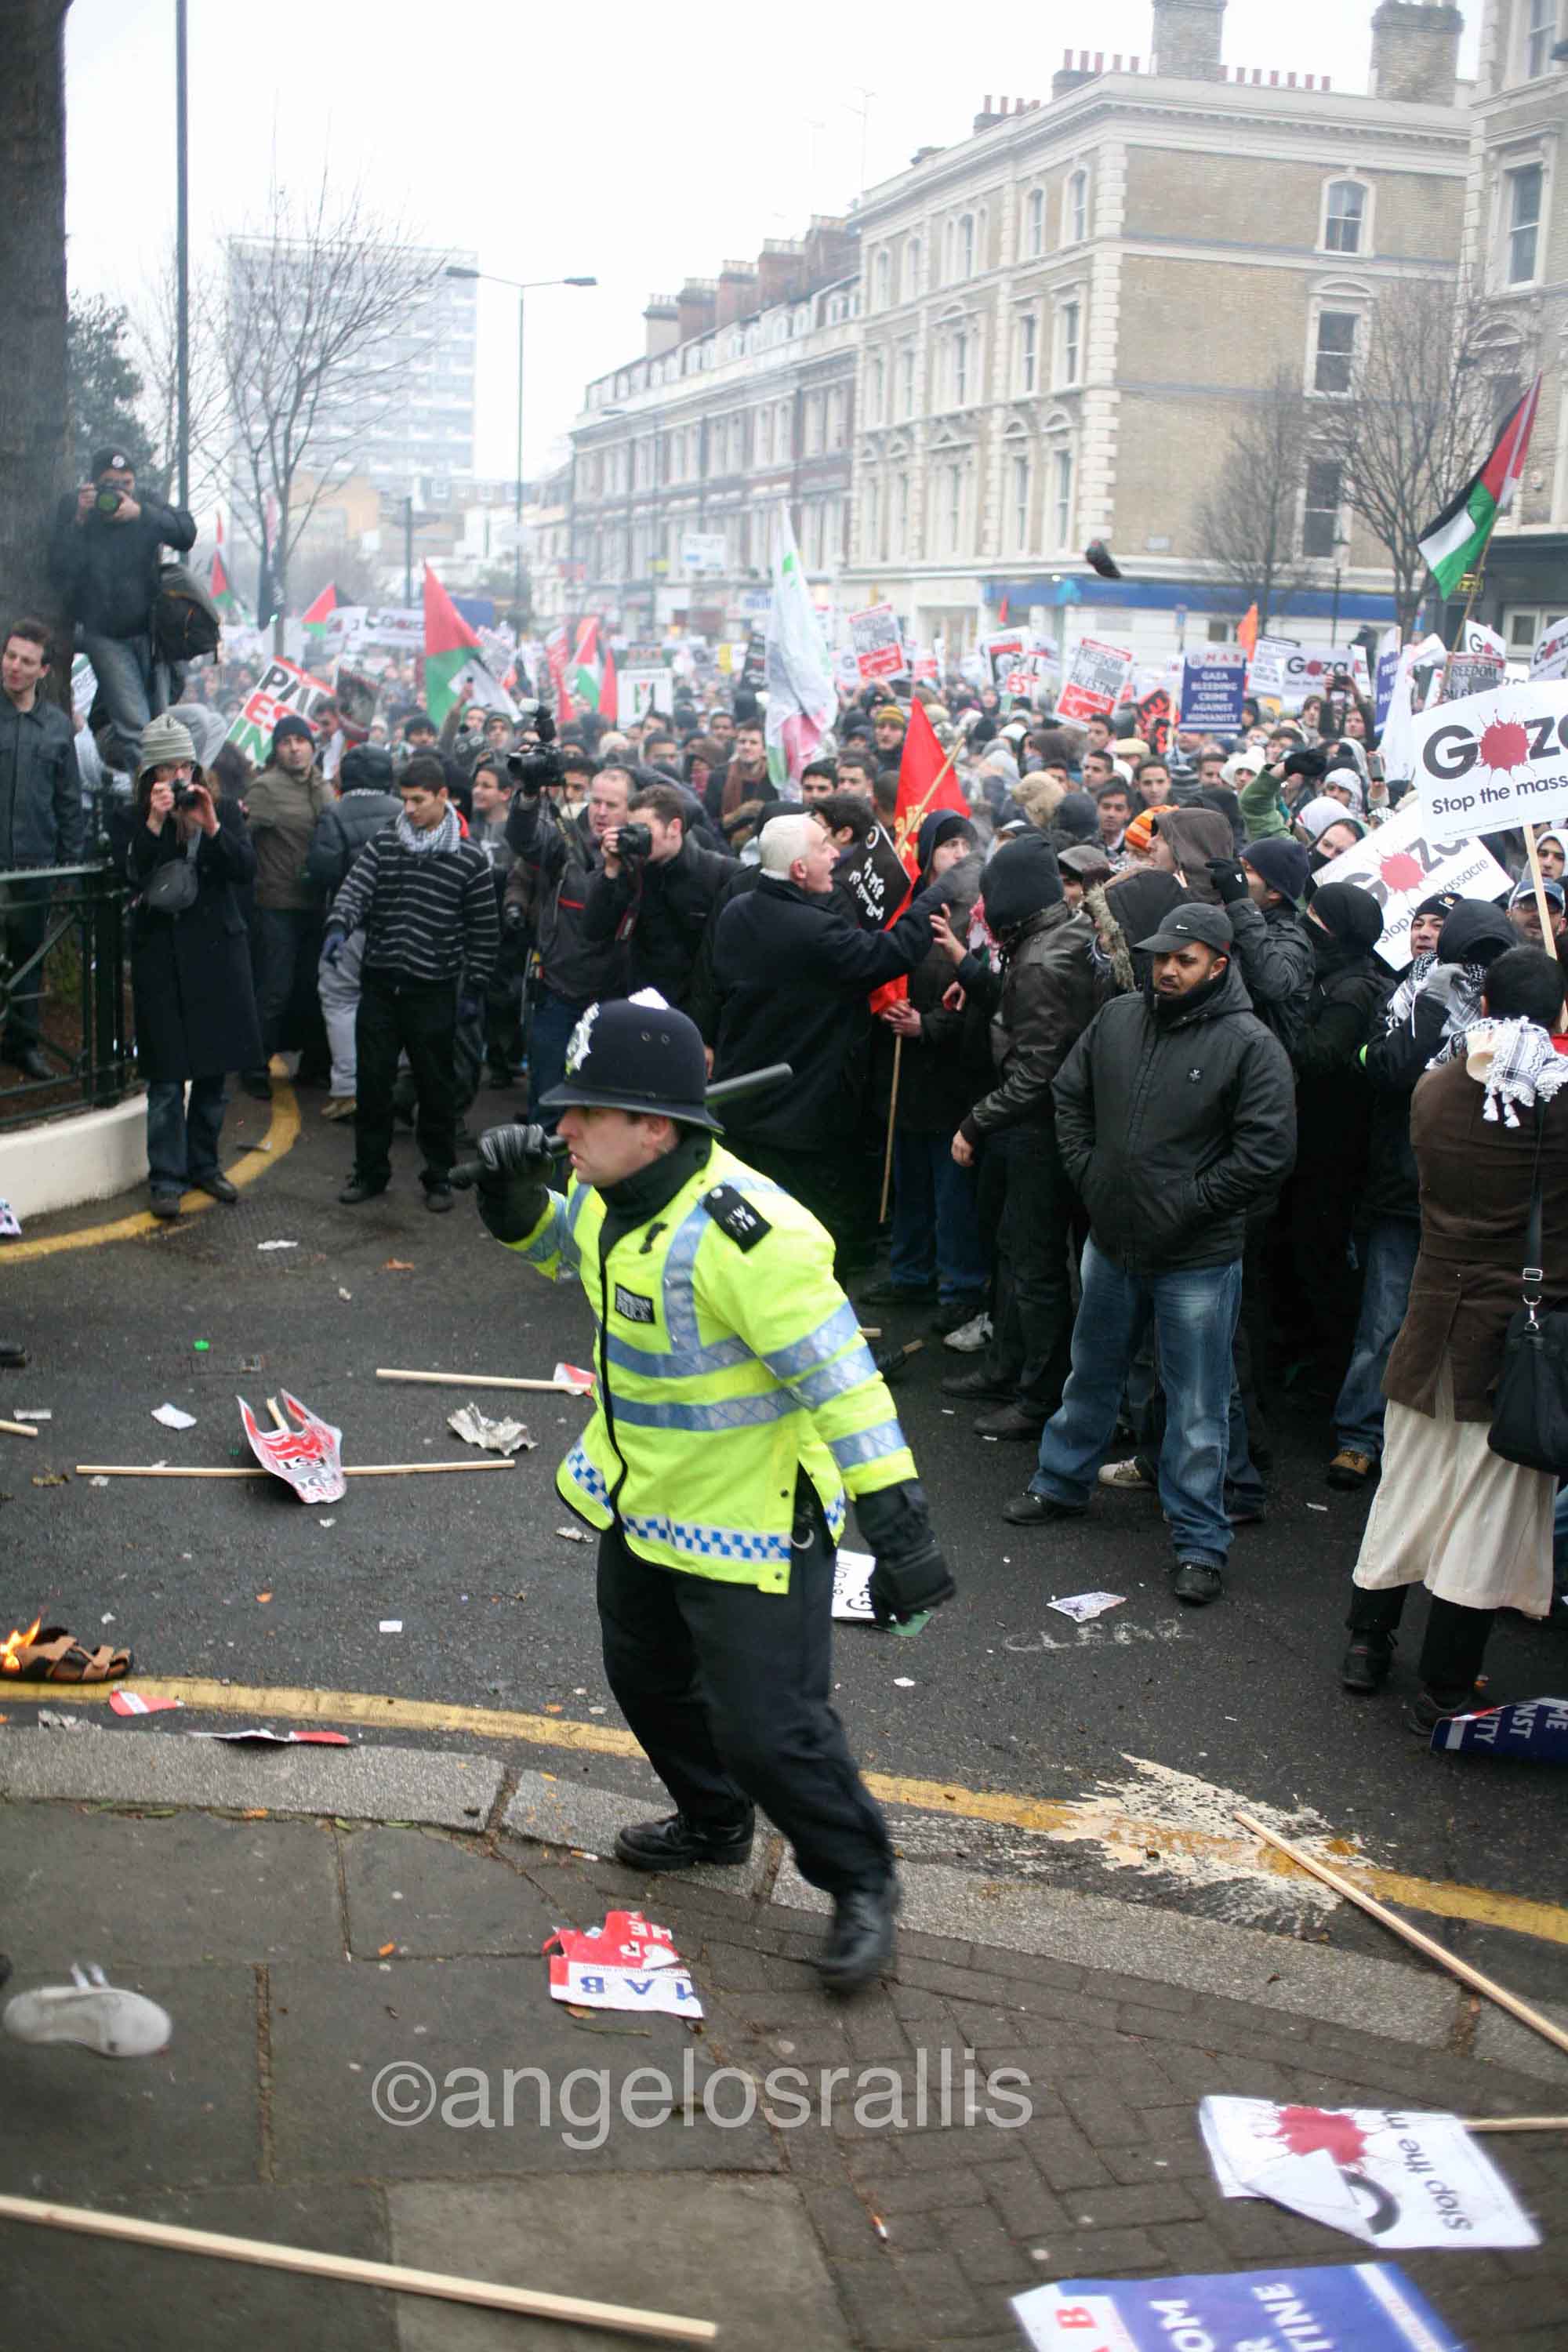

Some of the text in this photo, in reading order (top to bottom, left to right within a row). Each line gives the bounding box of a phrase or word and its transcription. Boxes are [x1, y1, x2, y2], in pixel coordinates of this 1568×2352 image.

[1432, 795, 1475, 815] Stop
[1480, 786, 1510, 804] the
[1399, 2138, 1436, 2174] the
[1425, 2179, 1473, 2232] Stop
